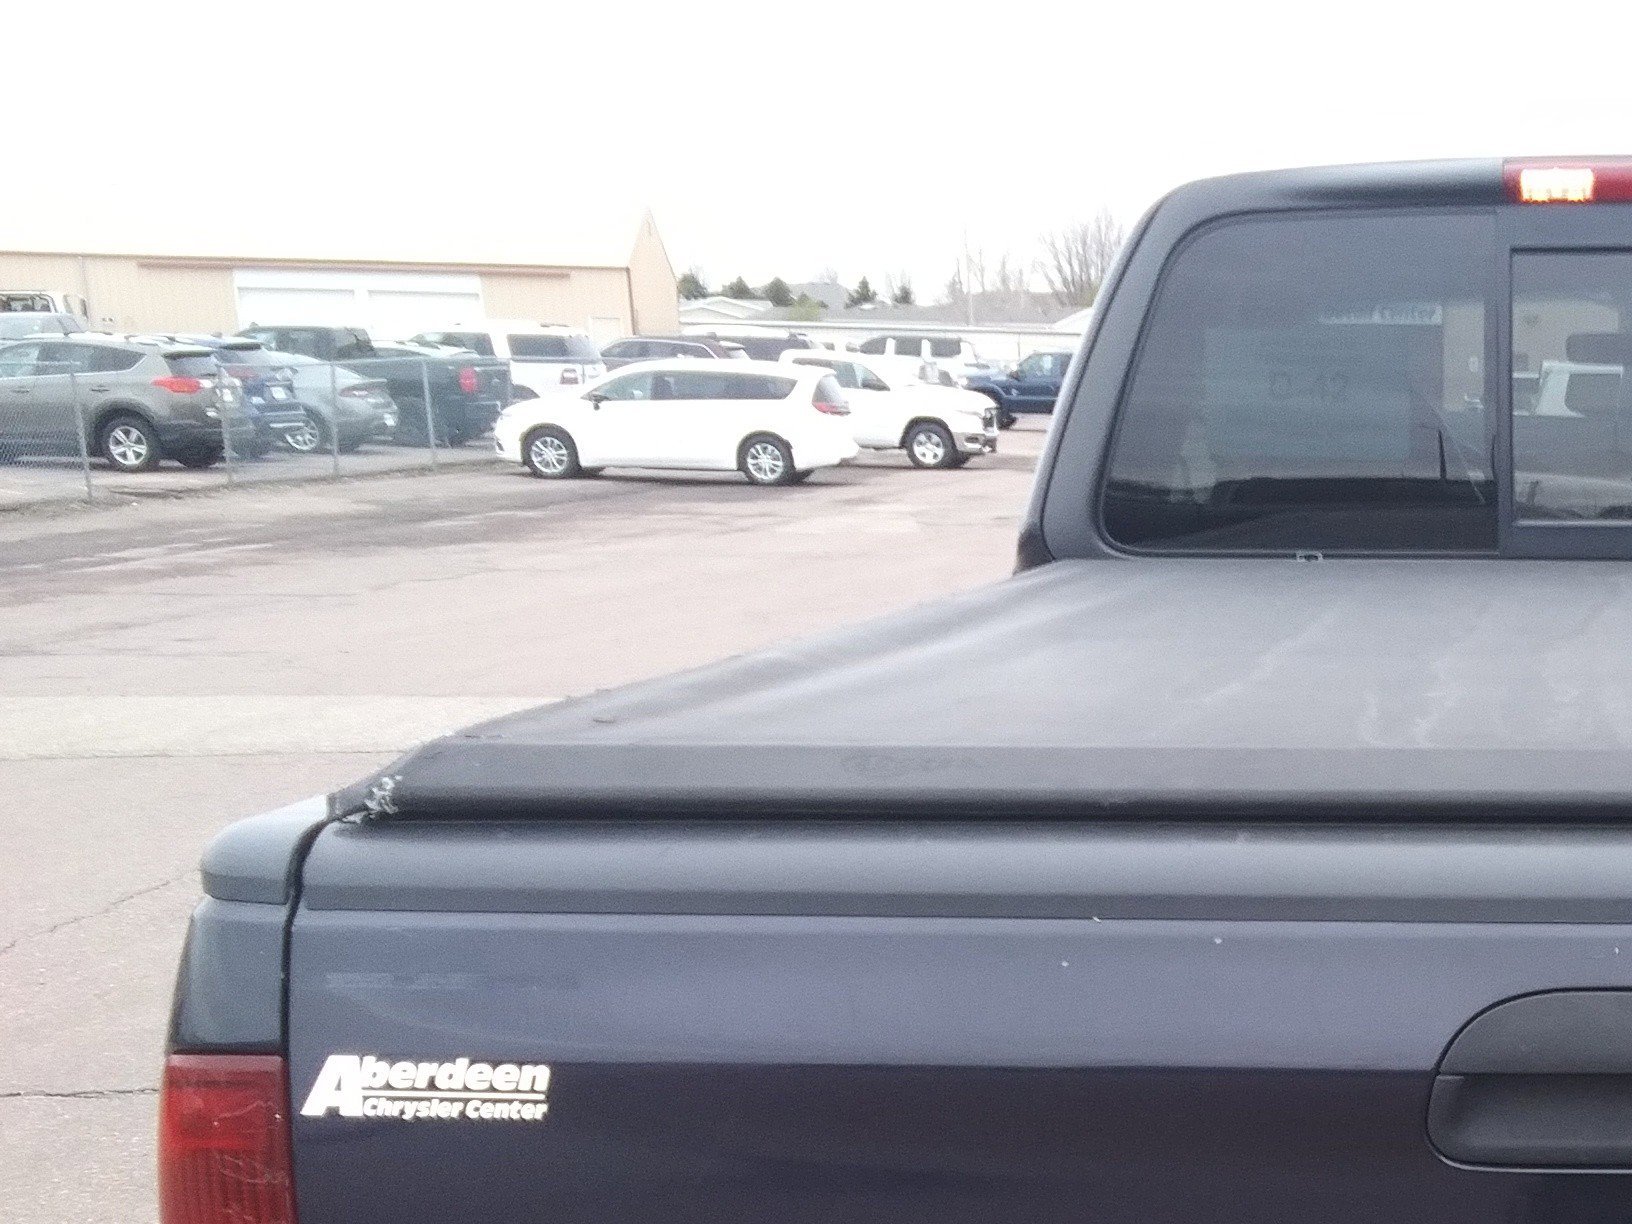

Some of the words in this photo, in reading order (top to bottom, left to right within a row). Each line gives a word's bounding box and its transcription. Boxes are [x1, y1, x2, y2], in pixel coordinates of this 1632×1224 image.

[299, 1054, 551, 1117] Aberdeen
[362, 1097, 464, 1120] Chrysler
[465, 1099, 548, 1120] Center
